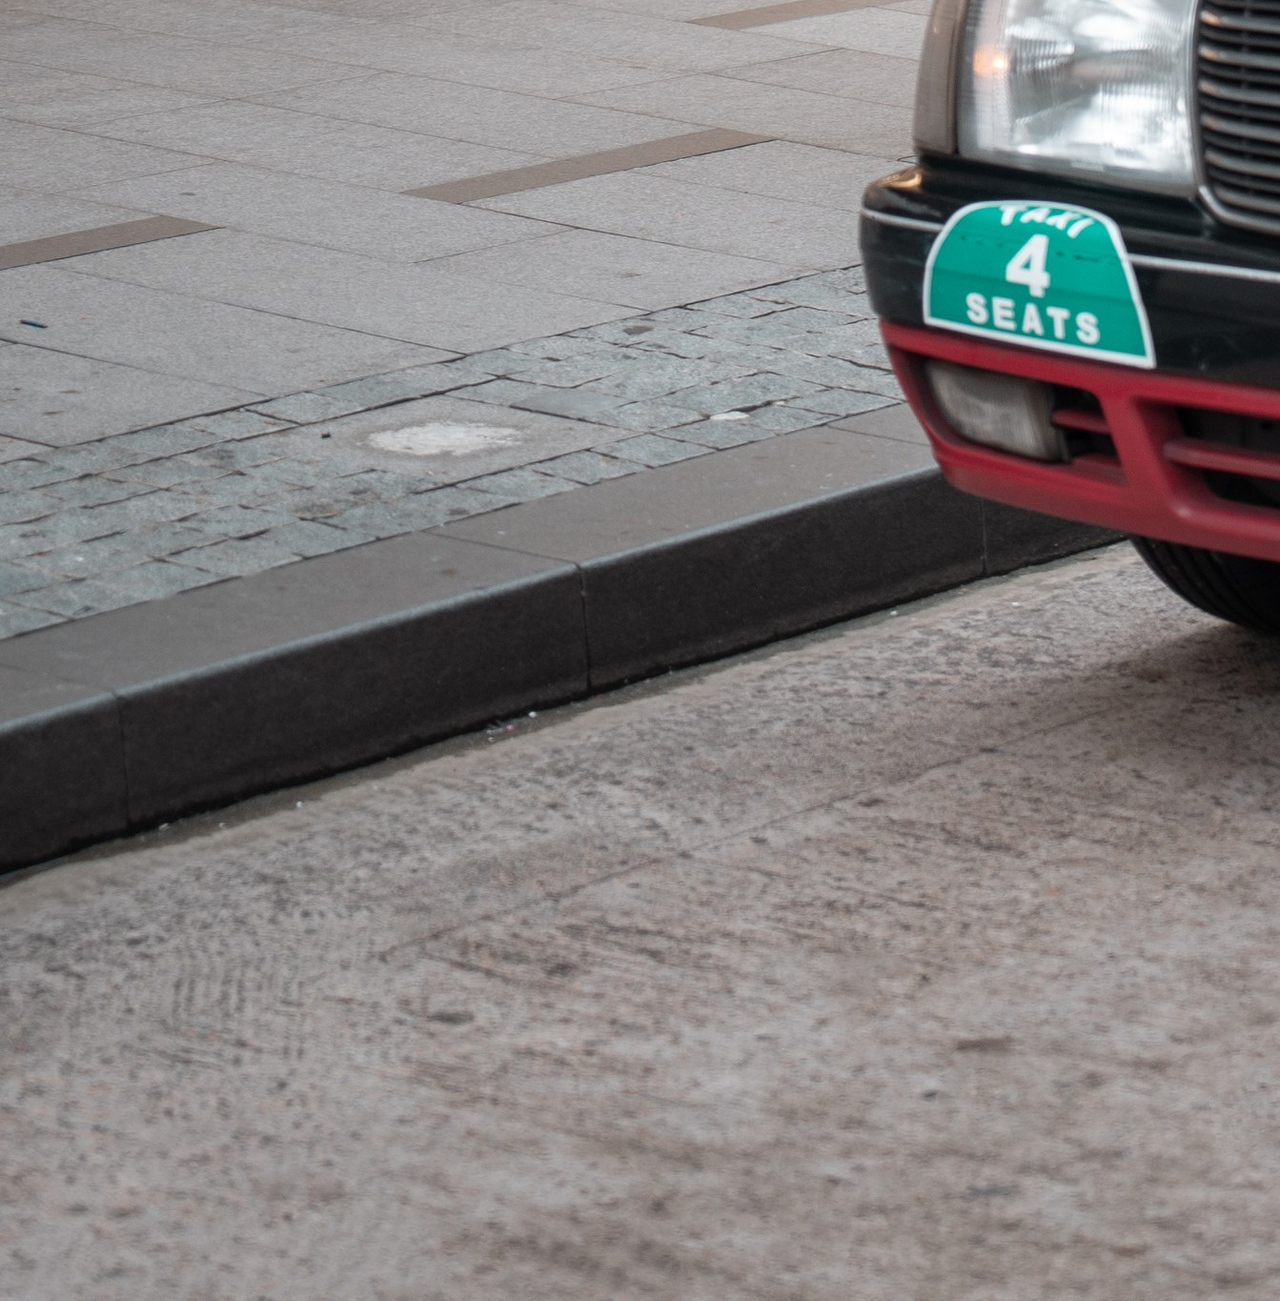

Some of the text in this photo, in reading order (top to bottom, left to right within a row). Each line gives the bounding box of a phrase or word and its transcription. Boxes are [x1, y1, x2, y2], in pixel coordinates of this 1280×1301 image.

[999, 205, 1095, 239] TAXI
[1005, 233, 1051, 298] 4
[966, 292, 1100, 345] SEATS
